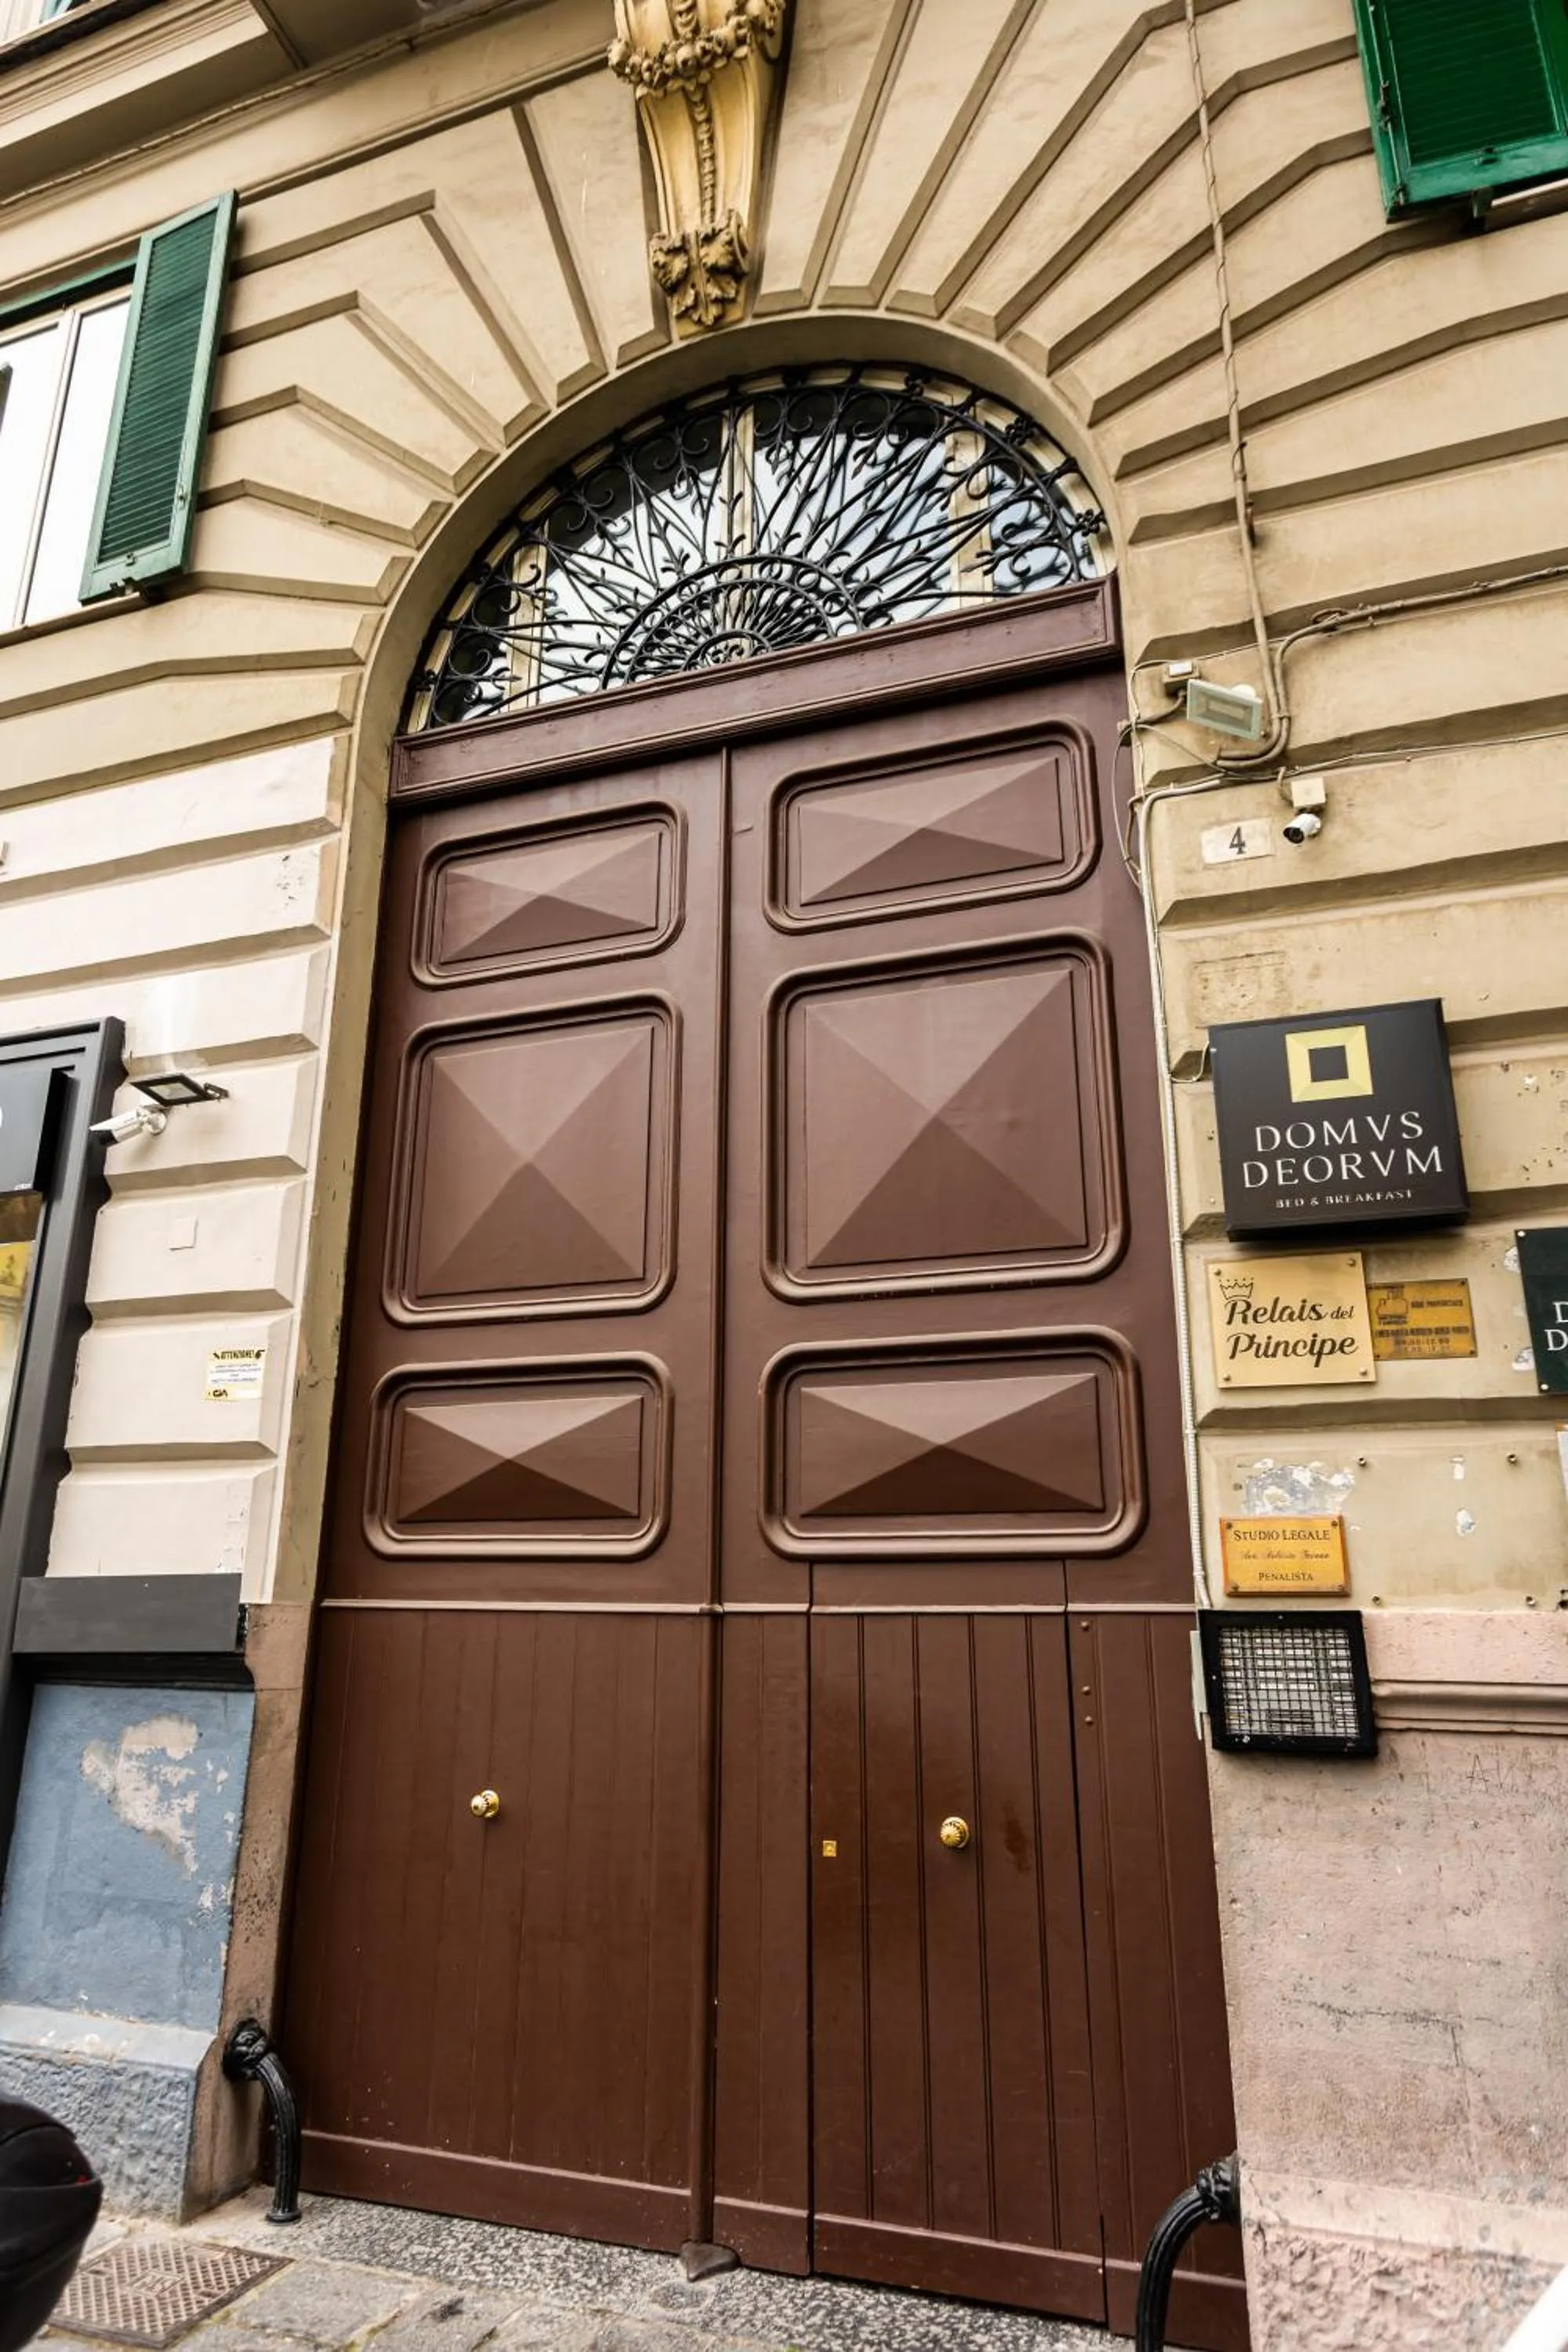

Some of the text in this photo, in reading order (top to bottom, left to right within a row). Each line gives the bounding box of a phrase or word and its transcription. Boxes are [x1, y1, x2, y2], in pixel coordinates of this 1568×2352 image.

[1229, 826, 1245, 855] 4
[1254, 1111, 1423, 1152] DOMVS
[1242, 1145, 1443, 1189] DEORVM
[1276, 1189, 1413, 1209] BED & BREAKFAST
[1225, 1296, 1355, 1326] Relais del
[1227, 1333, 1359, 1368] Principe
[1233, 1529, 1330, 1541] STUDIO LEGALE
[1258, 1572, 1314, 1581] PENALISTA
